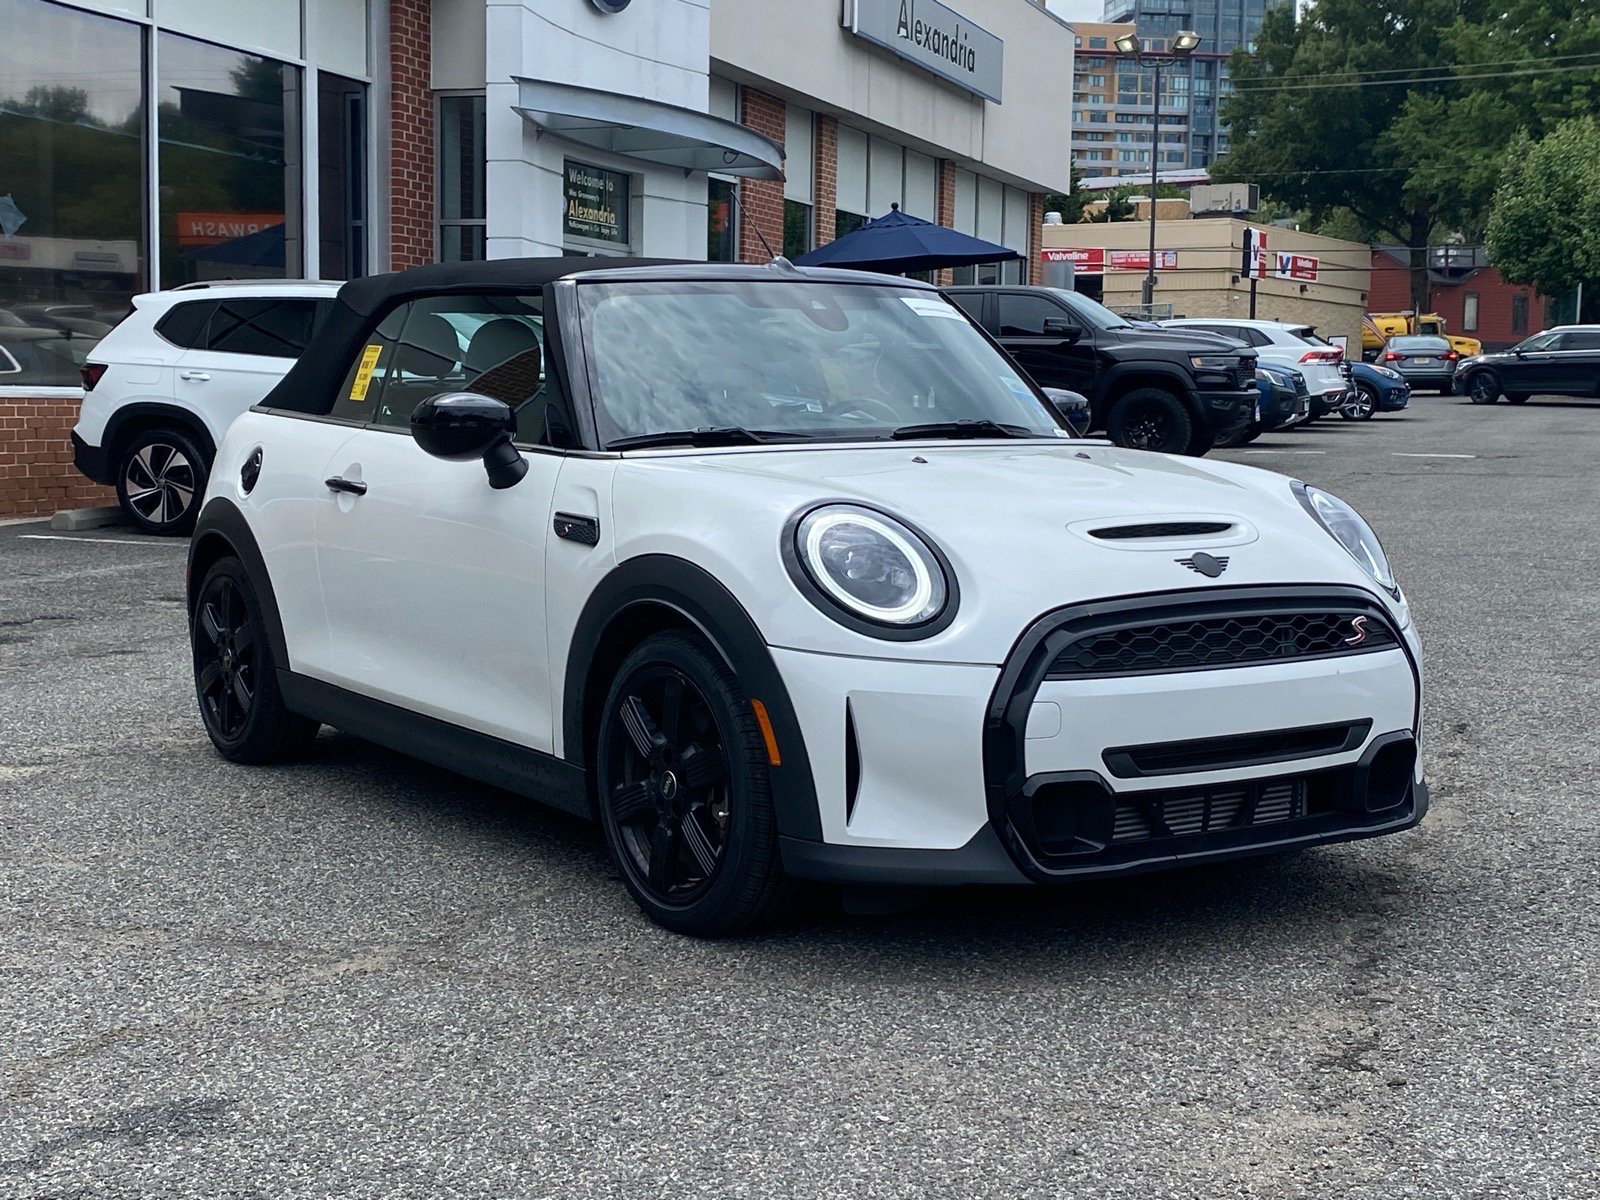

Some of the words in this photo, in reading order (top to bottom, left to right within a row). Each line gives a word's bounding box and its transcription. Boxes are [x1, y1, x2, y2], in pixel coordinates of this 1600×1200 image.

[897, 0, 976, 73] Alexandria
[568, 168, 604, 189] Welcome
[605, 178, 614, 192] to
[568, 199, 616, 224] Alexandria
[1047, 251, 1089, 261] Valvoline
[1344, 615, 1368, 646] S
